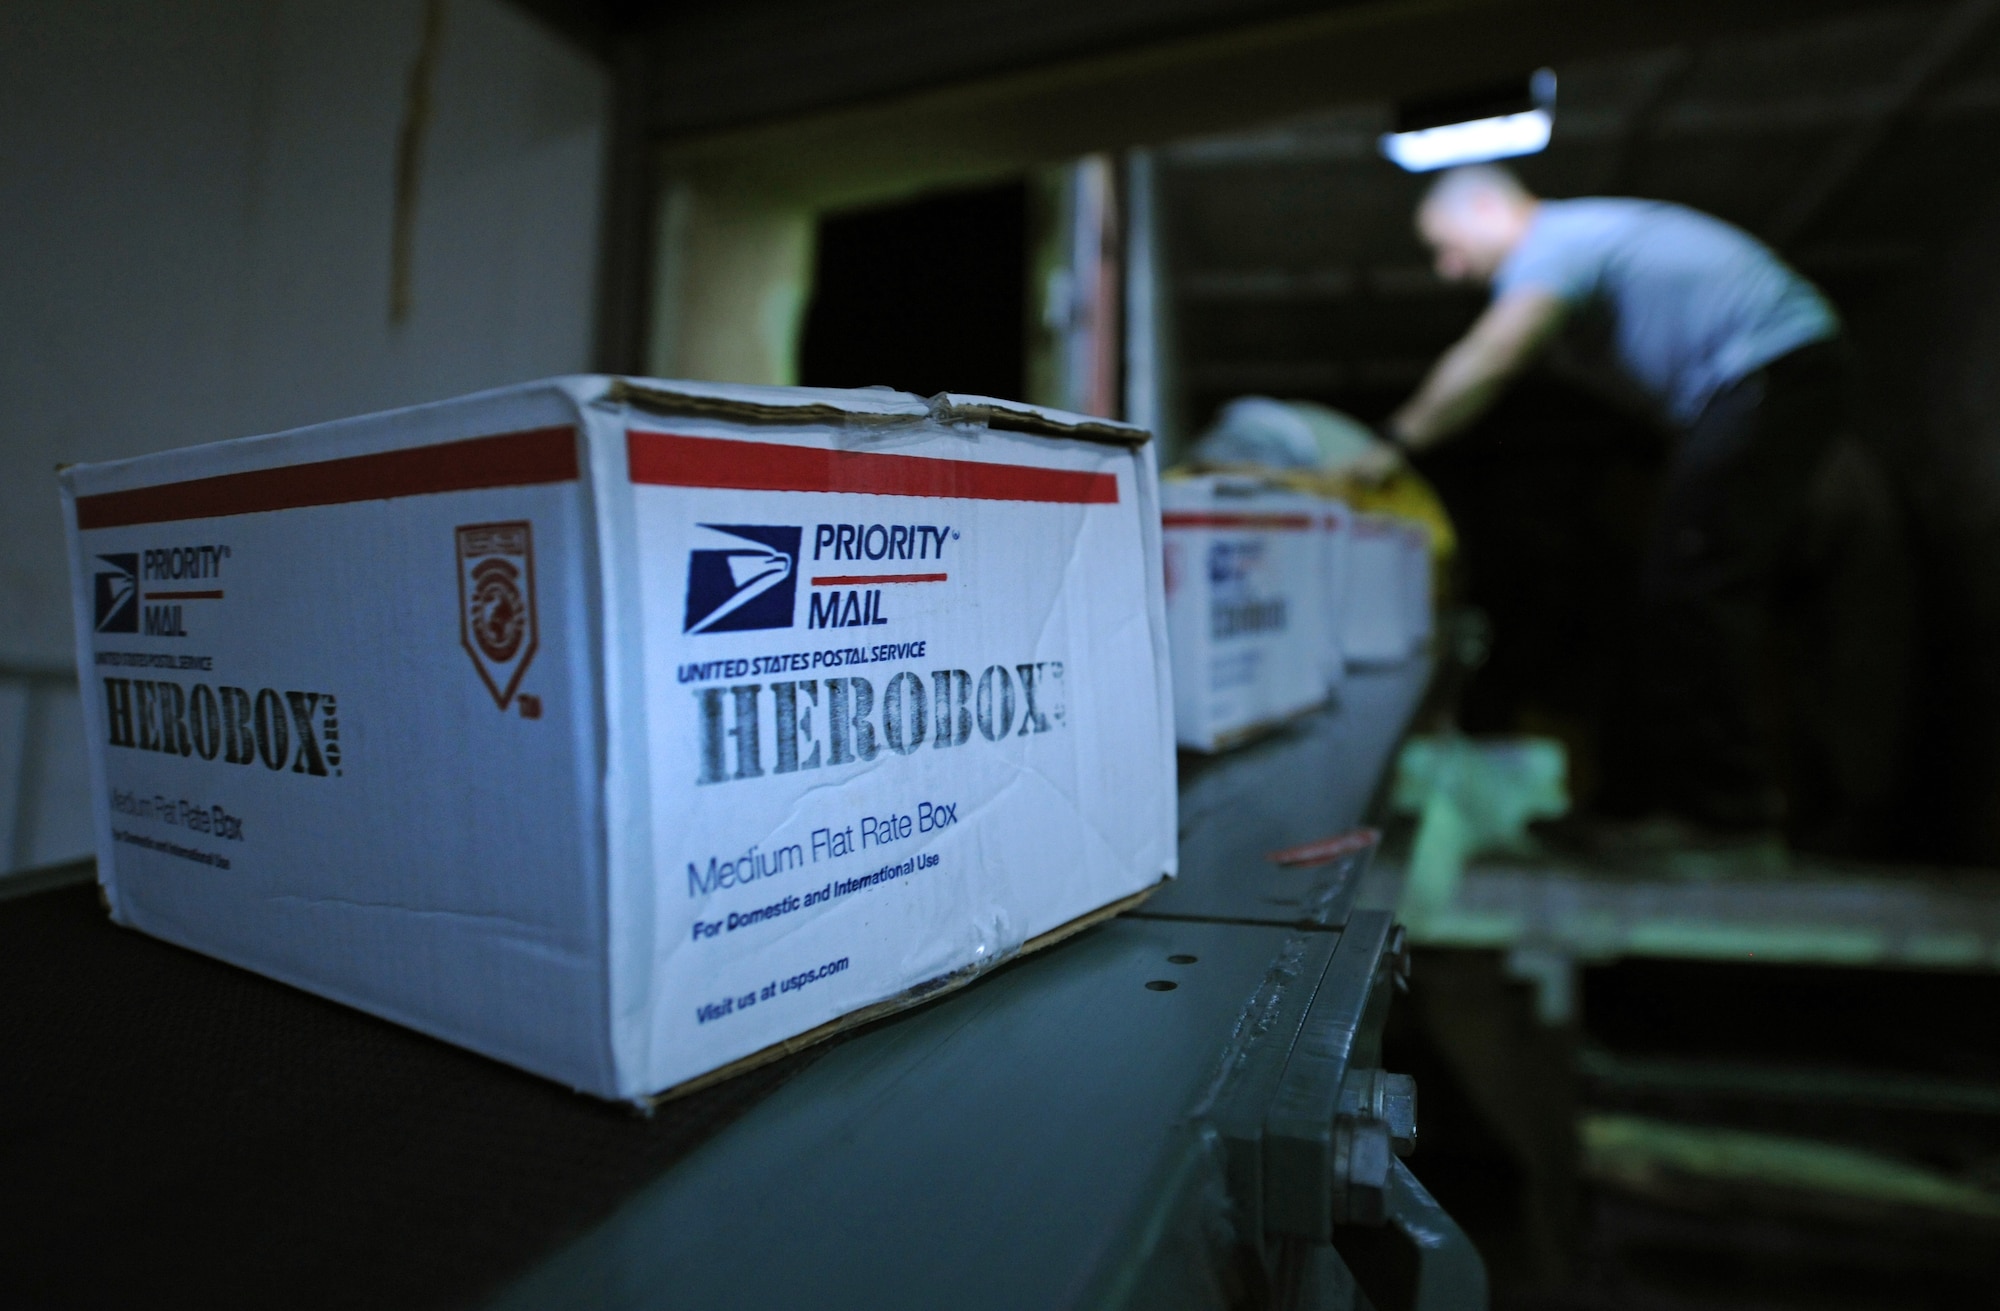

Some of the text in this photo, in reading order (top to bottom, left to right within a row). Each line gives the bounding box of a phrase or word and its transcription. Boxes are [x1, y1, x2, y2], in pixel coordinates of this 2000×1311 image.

[144, 545, 222, 579] PRIORITY
[813, 524, 951, 560] PRIORITY
[145, 605, 187, 636] MAIL
[808, 590, 888, 630] MAIL
[678, 640, 926, 684] UNITED STATES POSTAL SERVICE
[103, 677, 329, 777] HEROBOX
[693, 662, 1052, 786] HEROBOX
[687, 801, 958, 898] Medium Flat Rate Box
[692, 851, 940, 941] For Domestic and International Use
[696, 956, 849, 1025] Visit us at usps.com
